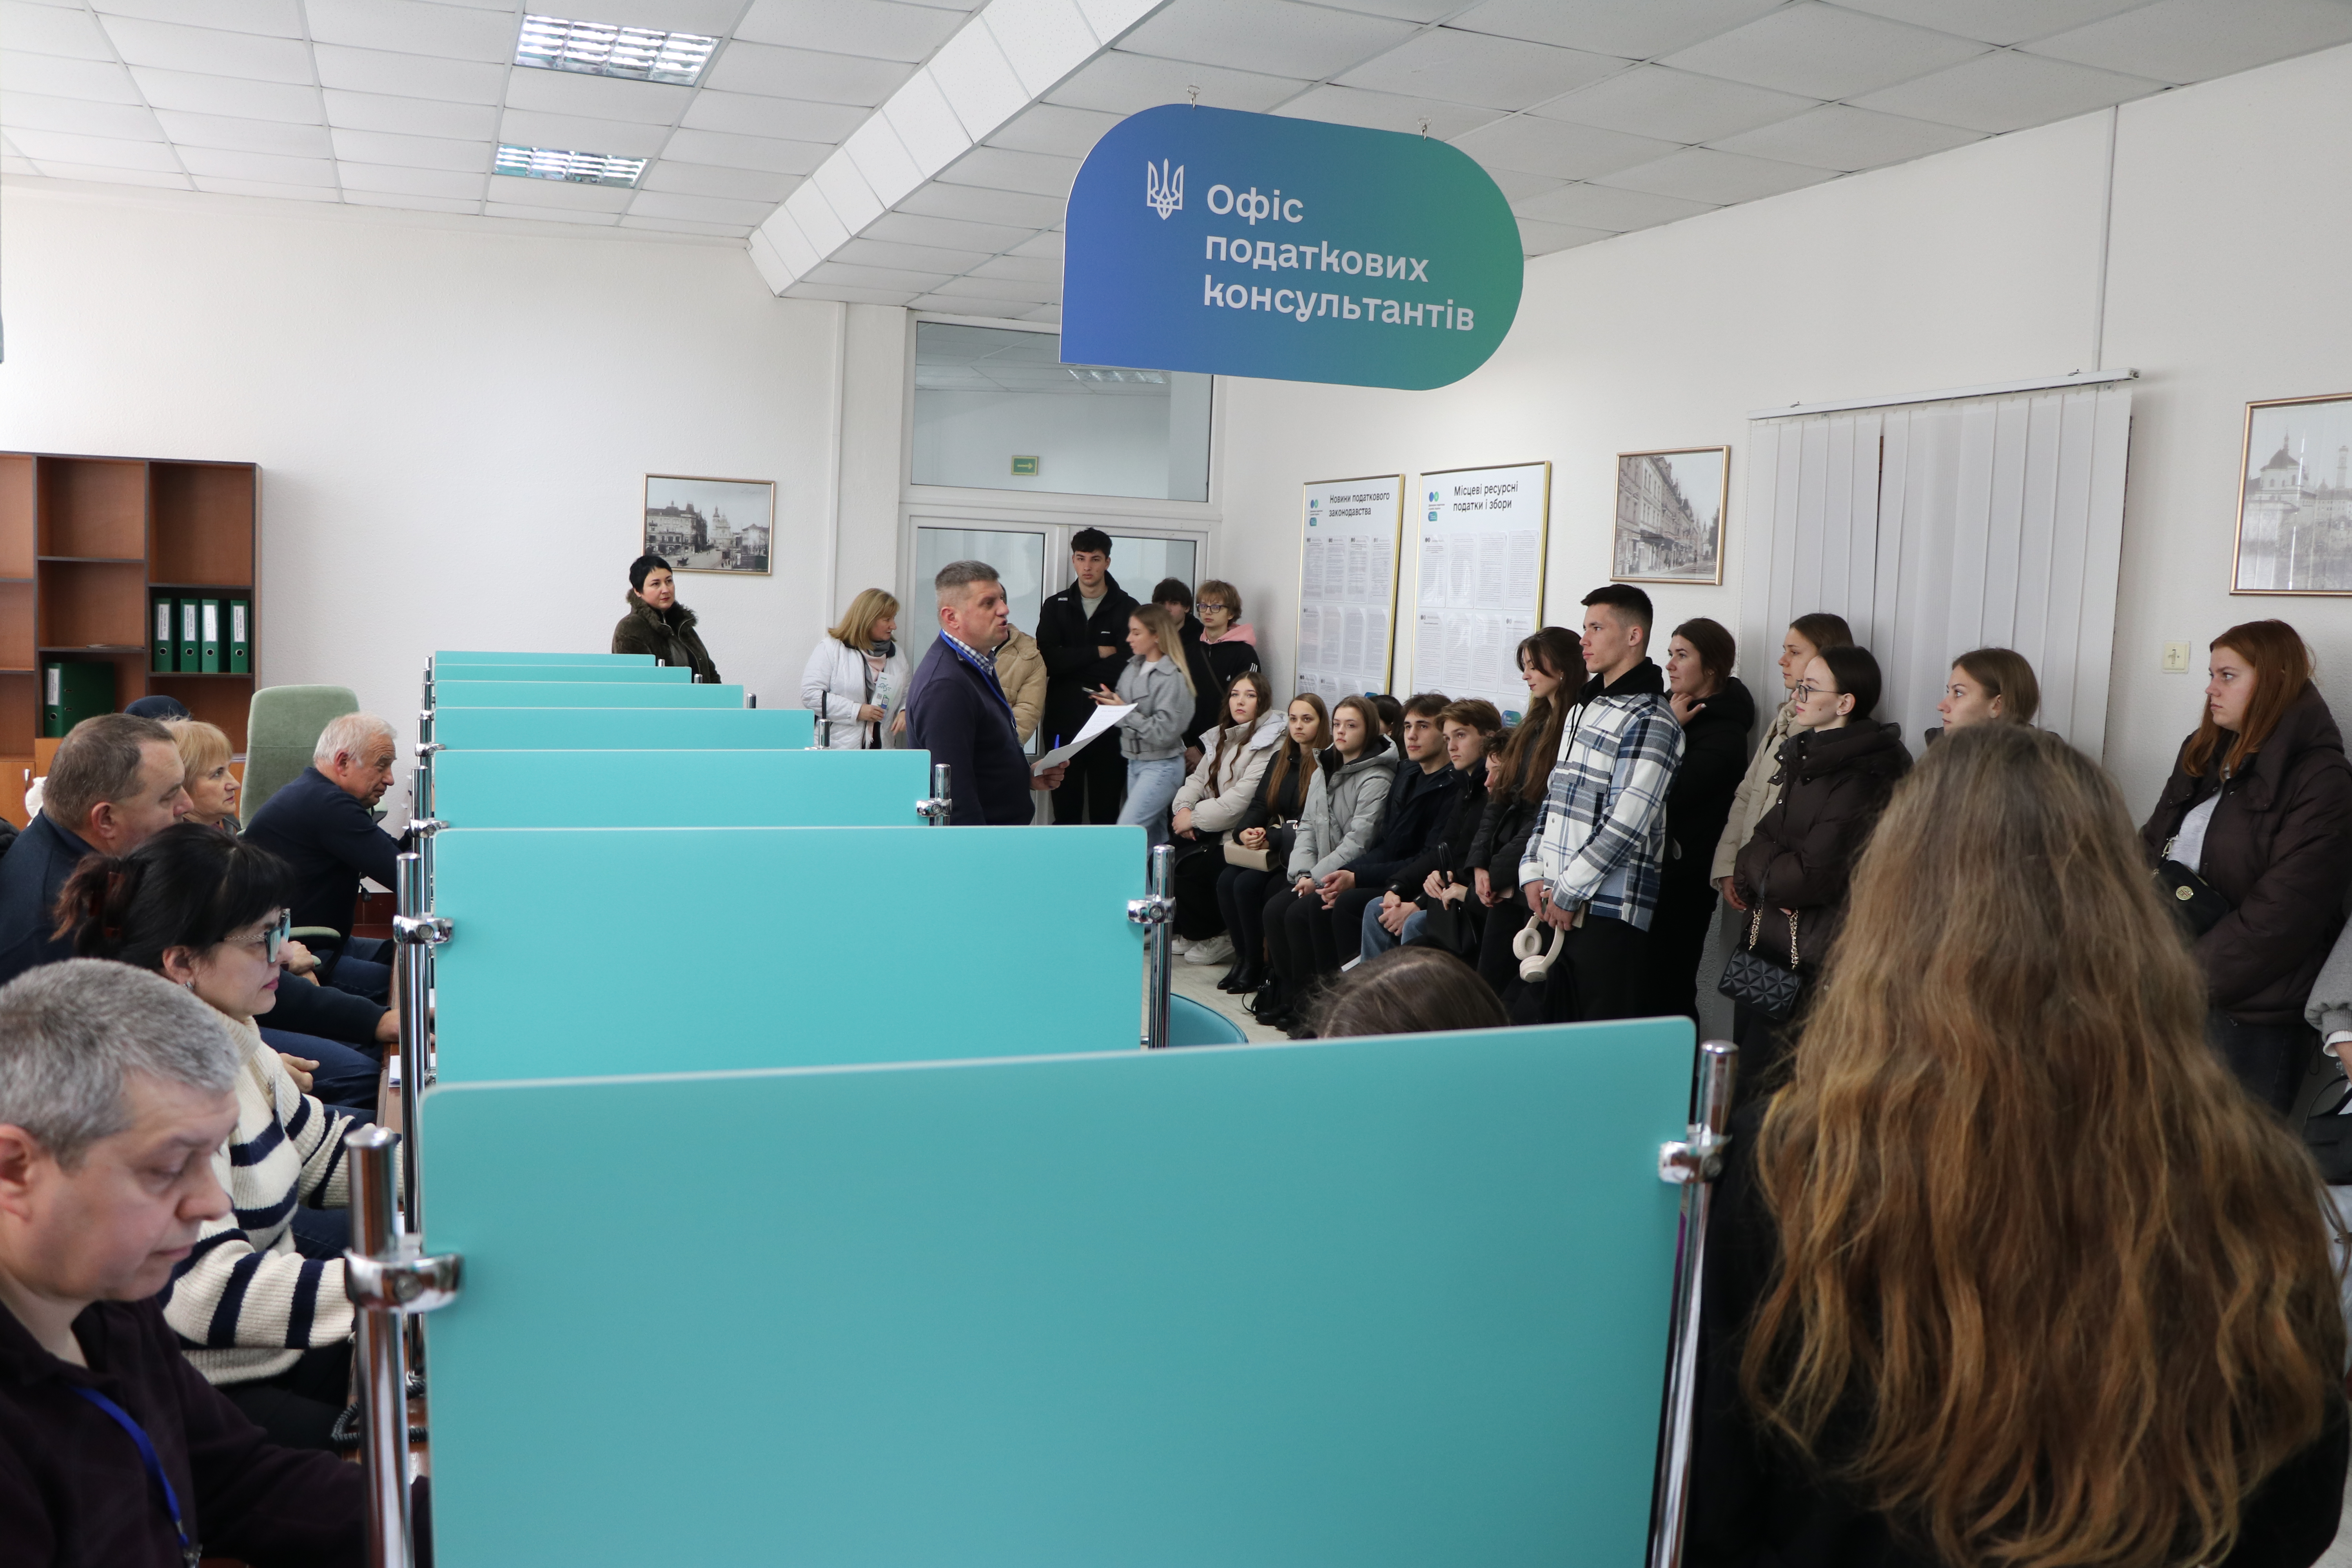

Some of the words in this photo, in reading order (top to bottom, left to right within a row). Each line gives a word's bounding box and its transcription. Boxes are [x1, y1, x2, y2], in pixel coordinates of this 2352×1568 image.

[1207, 184, 1303, 225] Офіс
[1206, 236, 1429, 283] податкових
[1204, 274, 1474, 331] консультантів
[1454, 483, 1482, 496] Місцеві
[1484, 481, 1518, 496] ресурсні
[1330, 495, 1351, 504] Новини
[1352, 492, 1390, 503] податкового
[1453, 502, 1483, 512] податки
[1485, 499, 1488, 510] і
[1489, 498, 1512, 511] збори
[1329, 507, 1371, 517] законодавства
